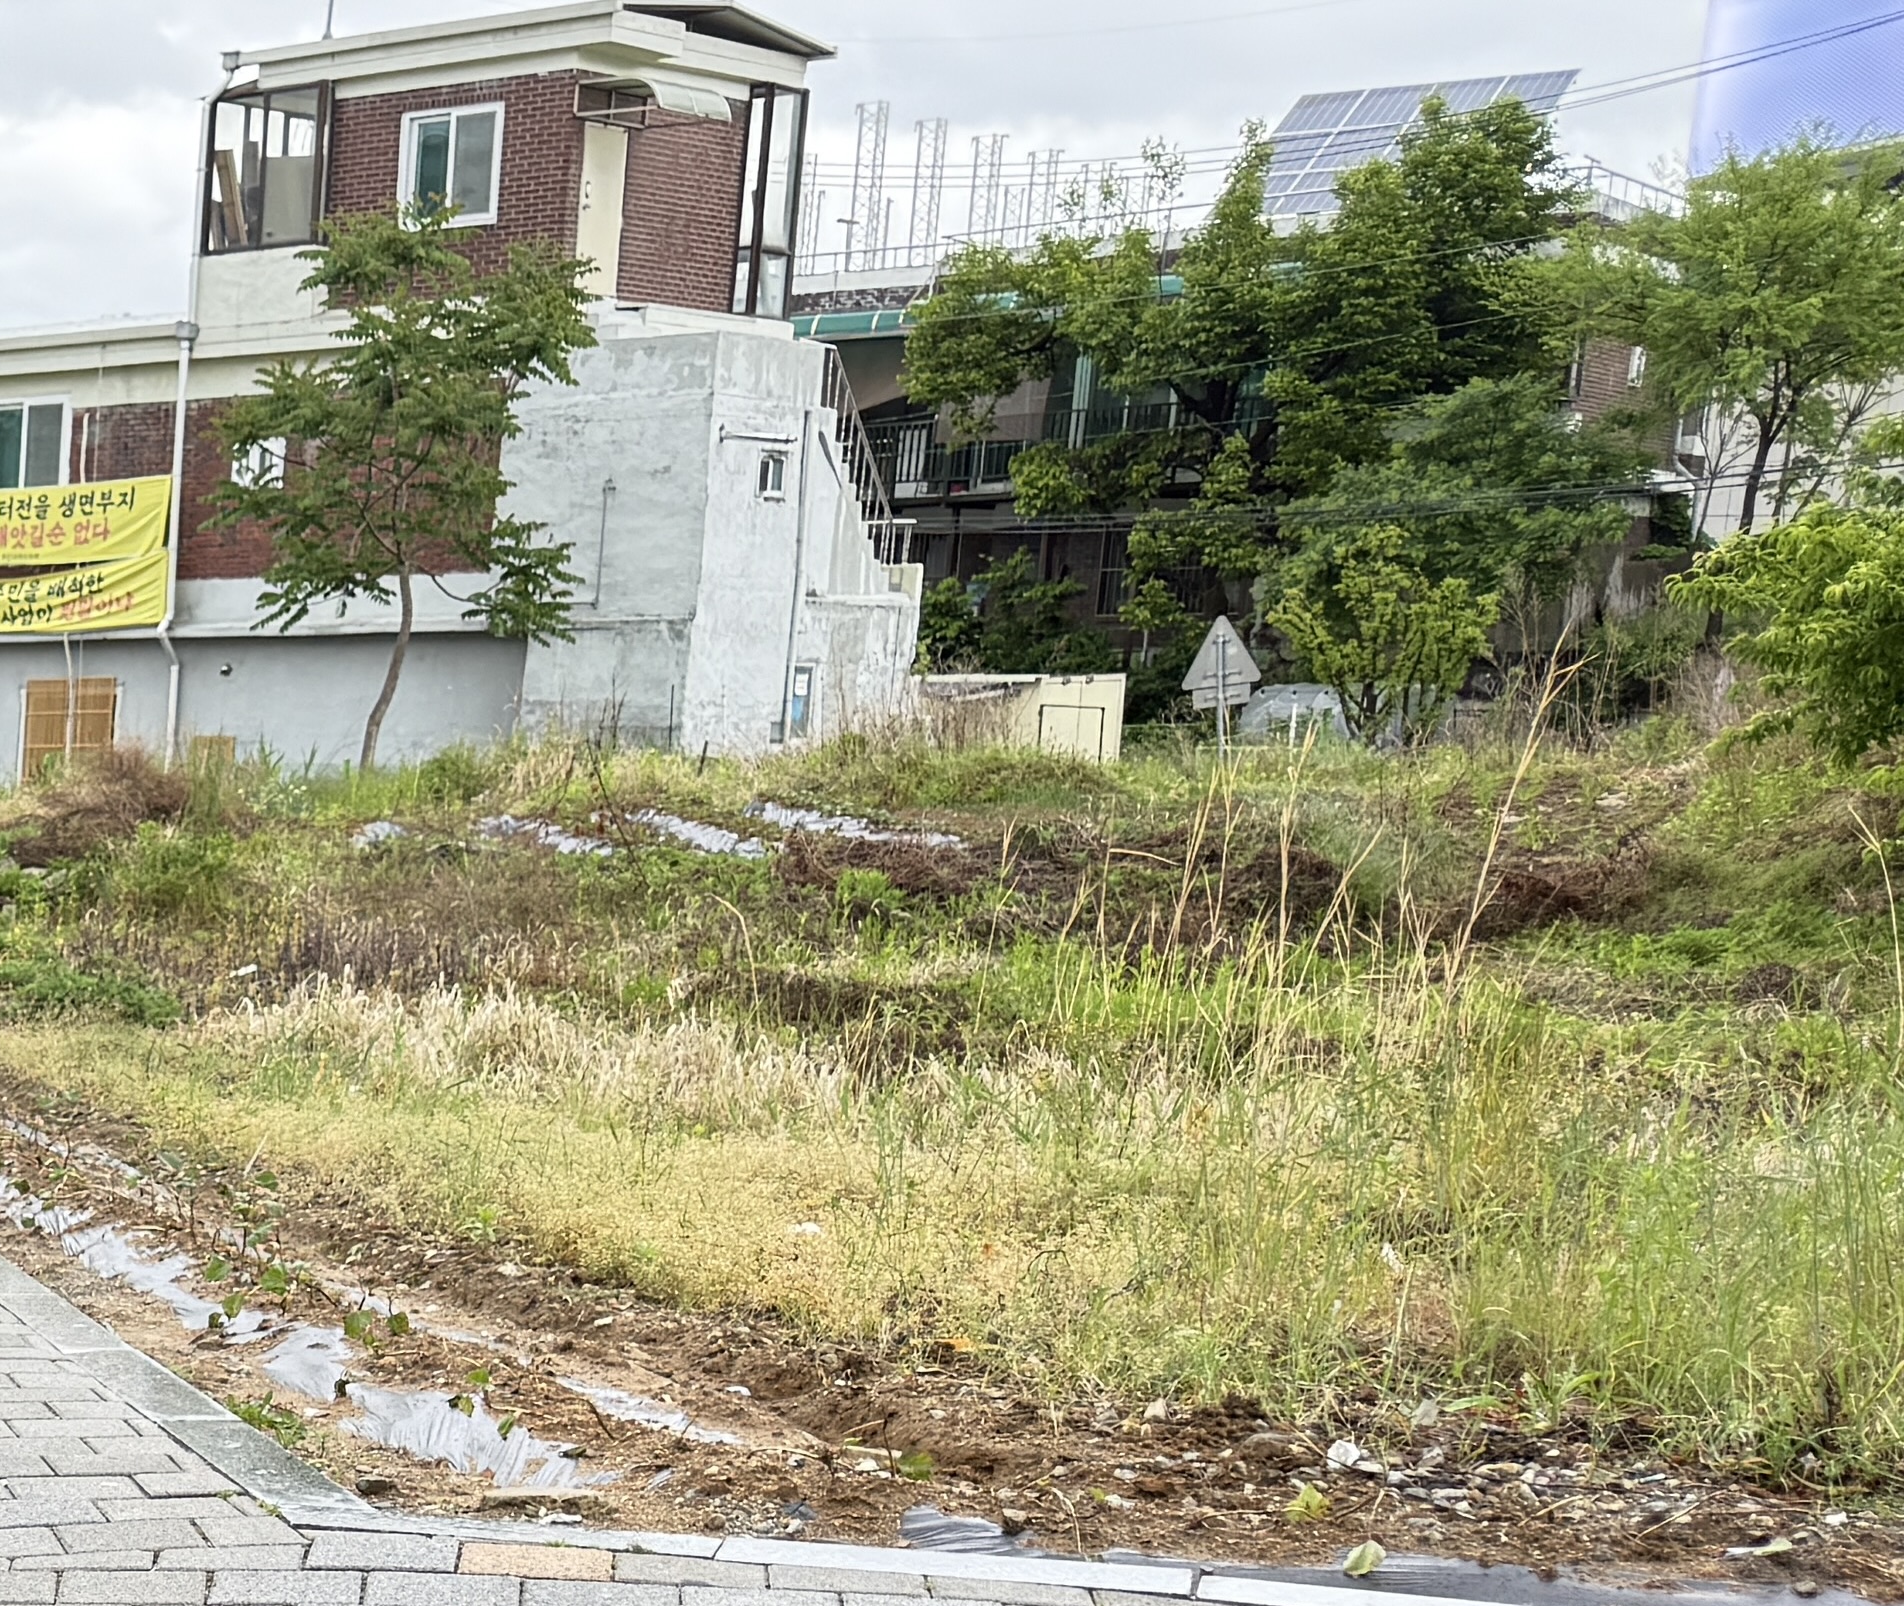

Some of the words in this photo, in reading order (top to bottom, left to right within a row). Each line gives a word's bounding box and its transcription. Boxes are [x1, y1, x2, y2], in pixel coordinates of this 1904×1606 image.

[59, 486, 136, 518] 생면부지
[74, 518, 111, 545] 없다
[1, 603, 54, 625] 사업이
